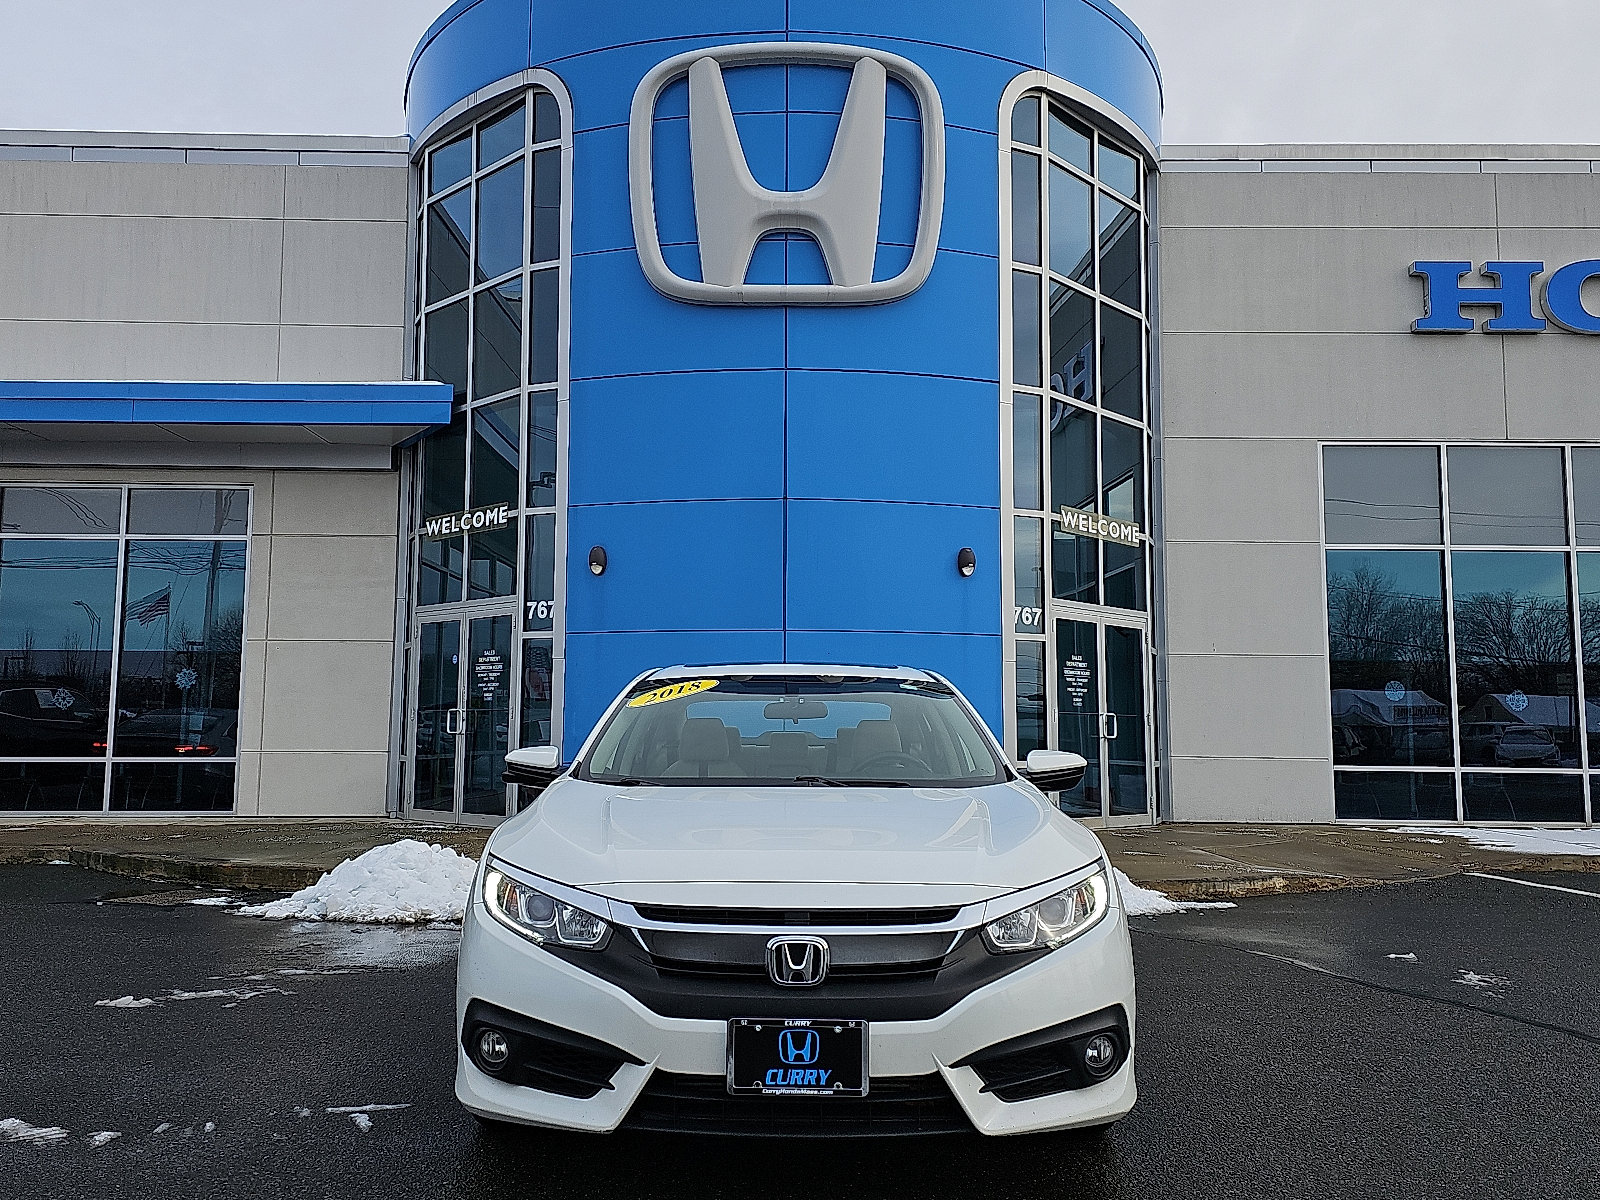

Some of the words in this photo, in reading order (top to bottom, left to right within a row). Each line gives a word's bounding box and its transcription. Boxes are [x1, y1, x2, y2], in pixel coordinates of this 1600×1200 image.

[425, 505, 509, 537] WELCOME
[1061, 509, 1139, 545] WELCOME
[526, 600, 555, 620] 767
[1014, 606, 1043, 626] 767
[644, 681, 702, 705] 2018
[765, 1068, 832, 1086] CURRY
